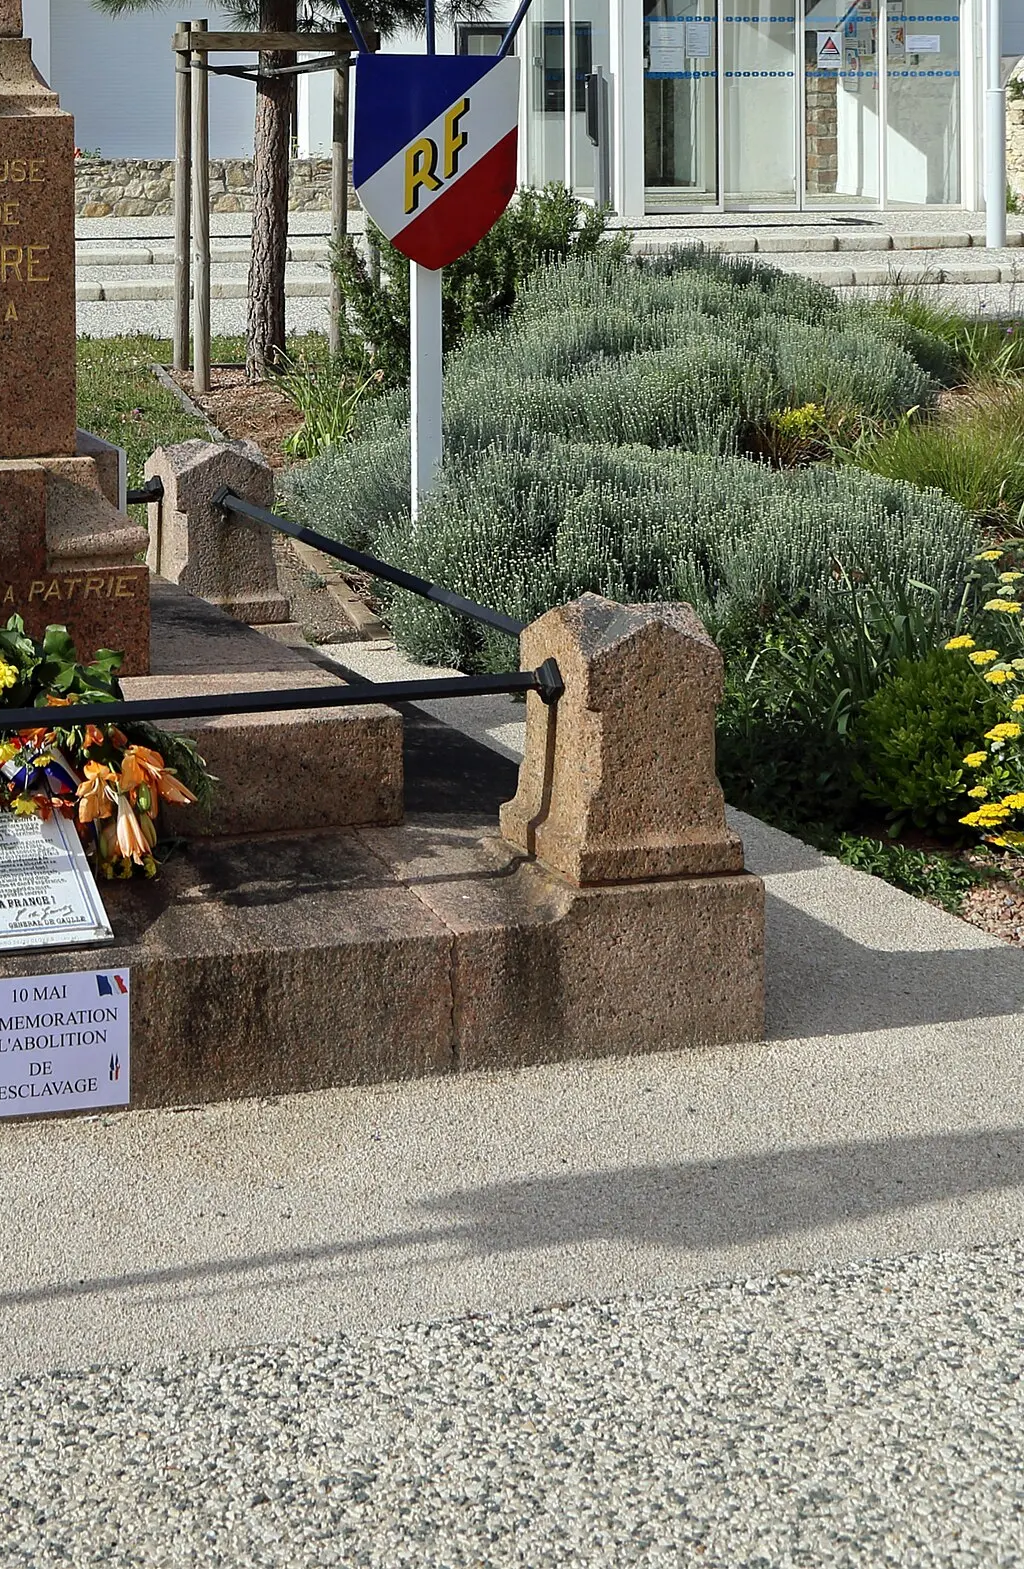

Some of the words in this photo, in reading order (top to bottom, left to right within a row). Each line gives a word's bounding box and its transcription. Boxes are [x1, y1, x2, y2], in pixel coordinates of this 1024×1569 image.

[404, 97, 470, 214] RF
[27, 575, 139, 603] PATRIE
[12, 988, 28, 1003] 10
[34, 985, 66, 1001] MAI
[29, 1061, 52, 1076] DE
